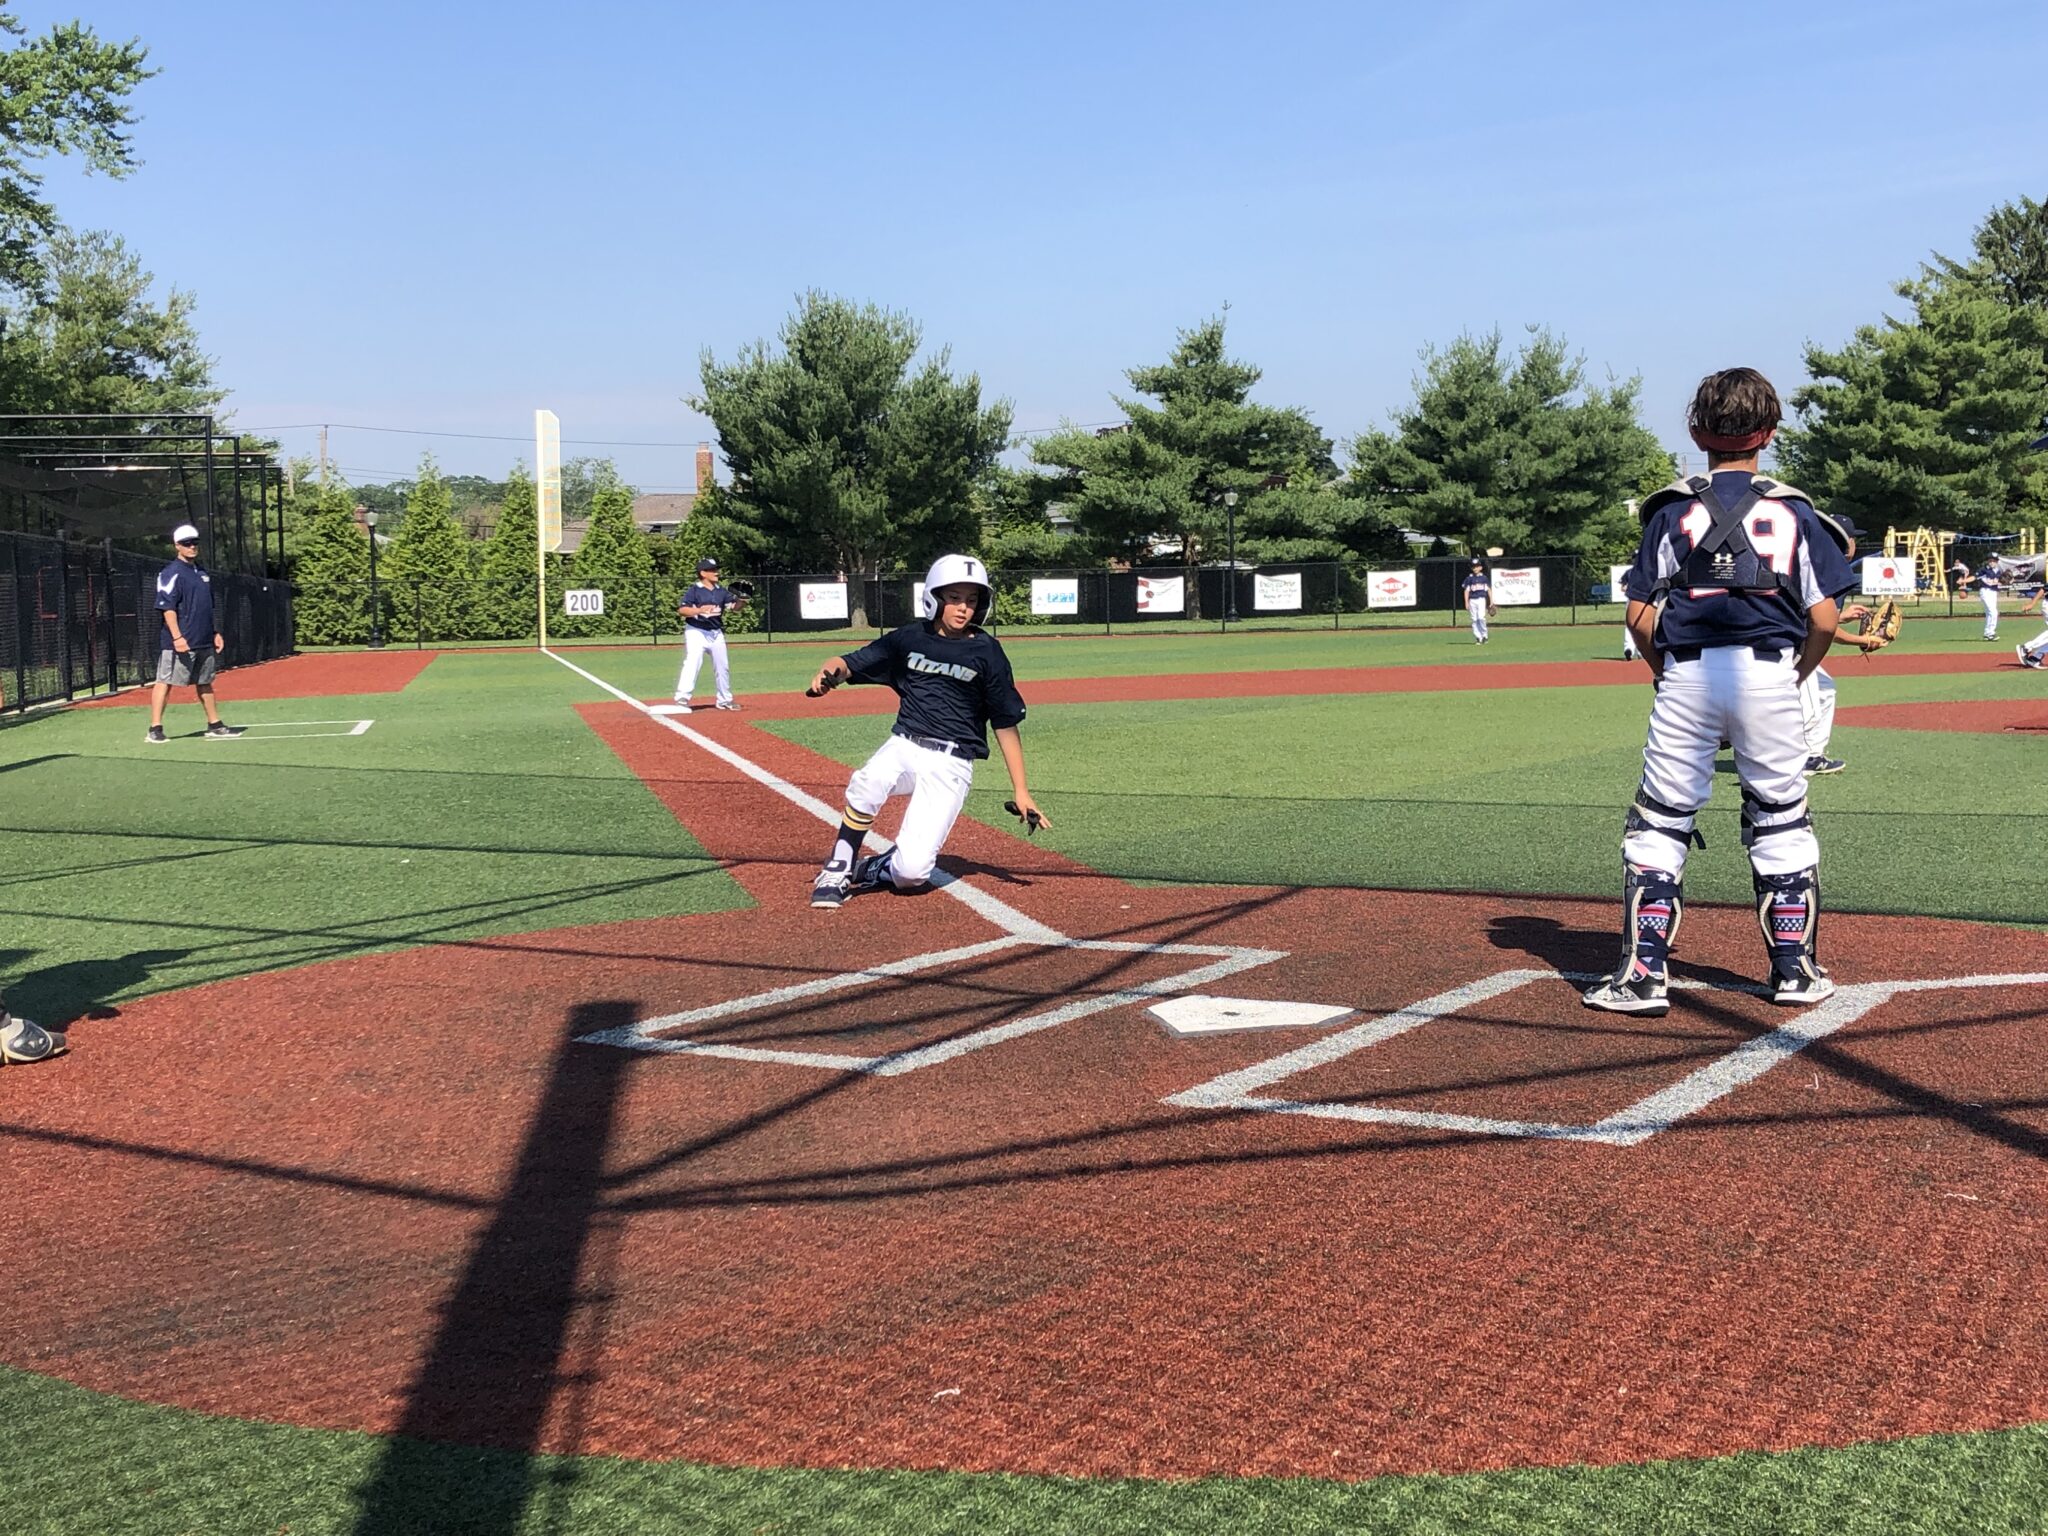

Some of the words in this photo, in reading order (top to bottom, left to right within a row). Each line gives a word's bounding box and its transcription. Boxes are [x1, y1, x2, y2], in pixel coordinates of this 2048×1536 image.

[1679, 498, 1798, 600] 19
[963, 561, 976, 577] T
[570, 593, 599, 612] 200
[906, 651, 978, 683] TITANS
